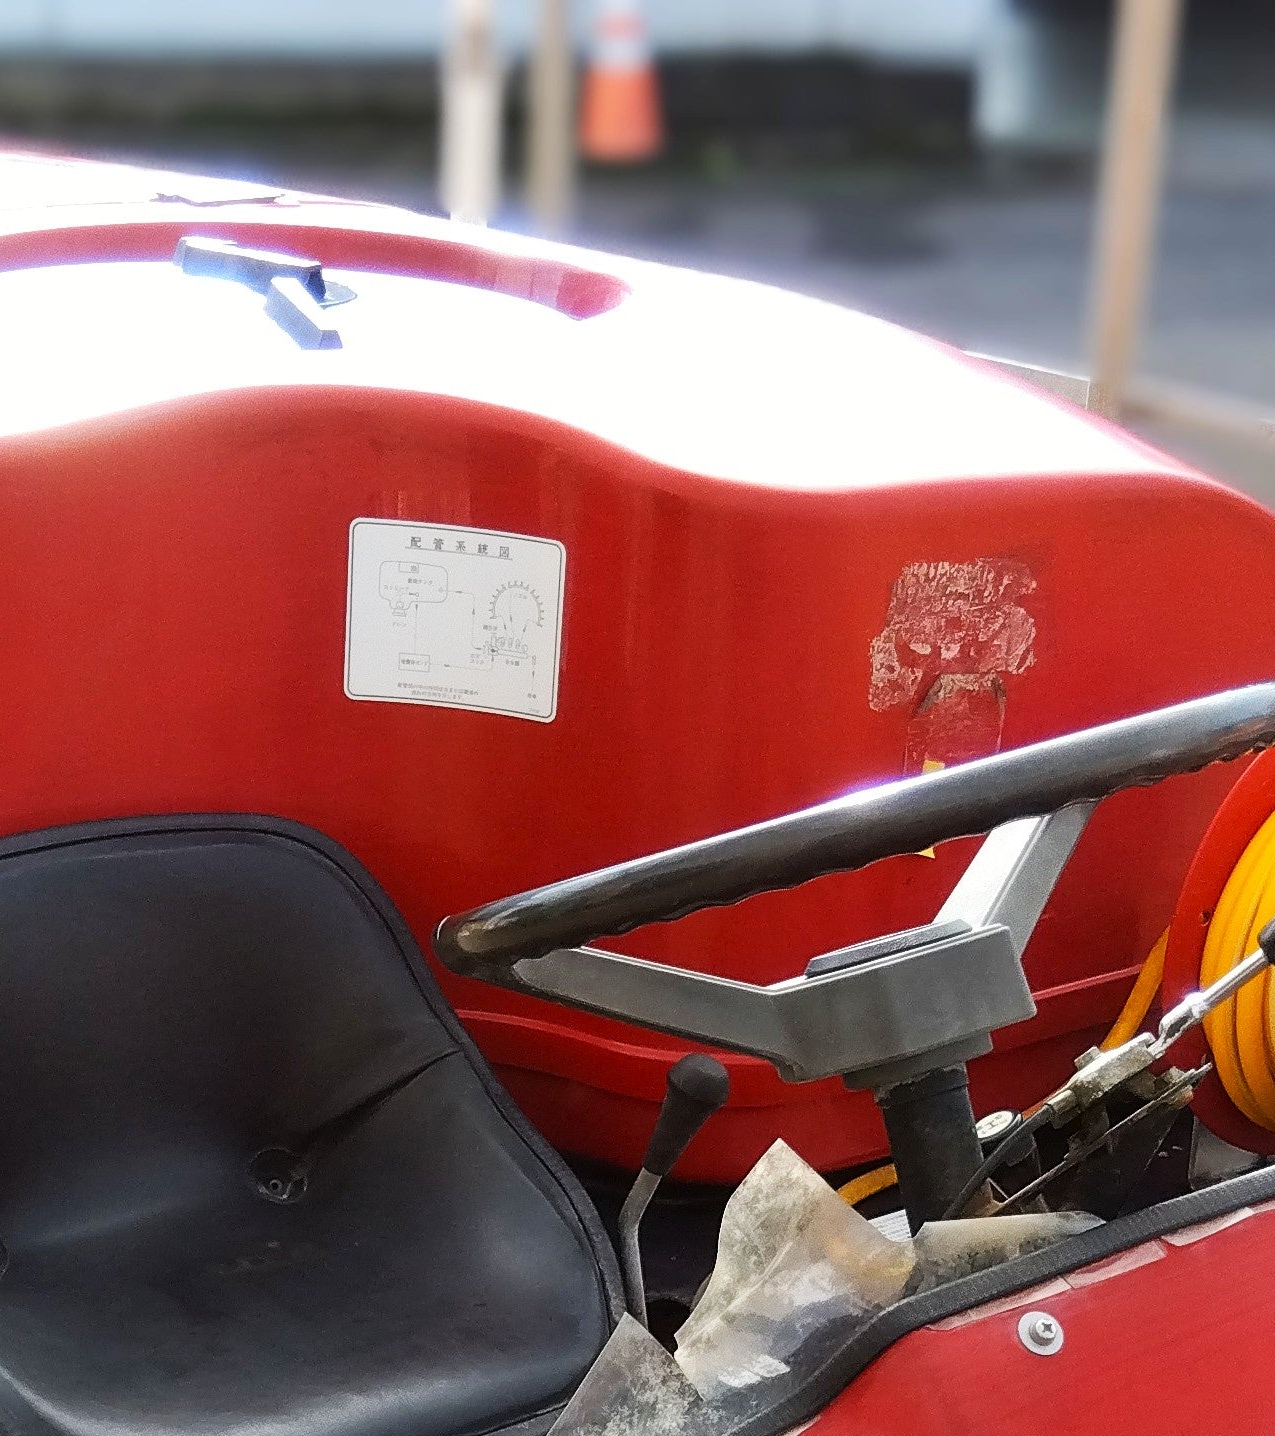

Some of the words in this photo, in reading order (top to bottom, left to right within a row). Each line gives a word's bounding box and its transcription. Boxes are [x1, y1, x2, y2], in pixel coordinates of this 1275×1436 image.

[410, 536, 510, 558] 配管系統図
